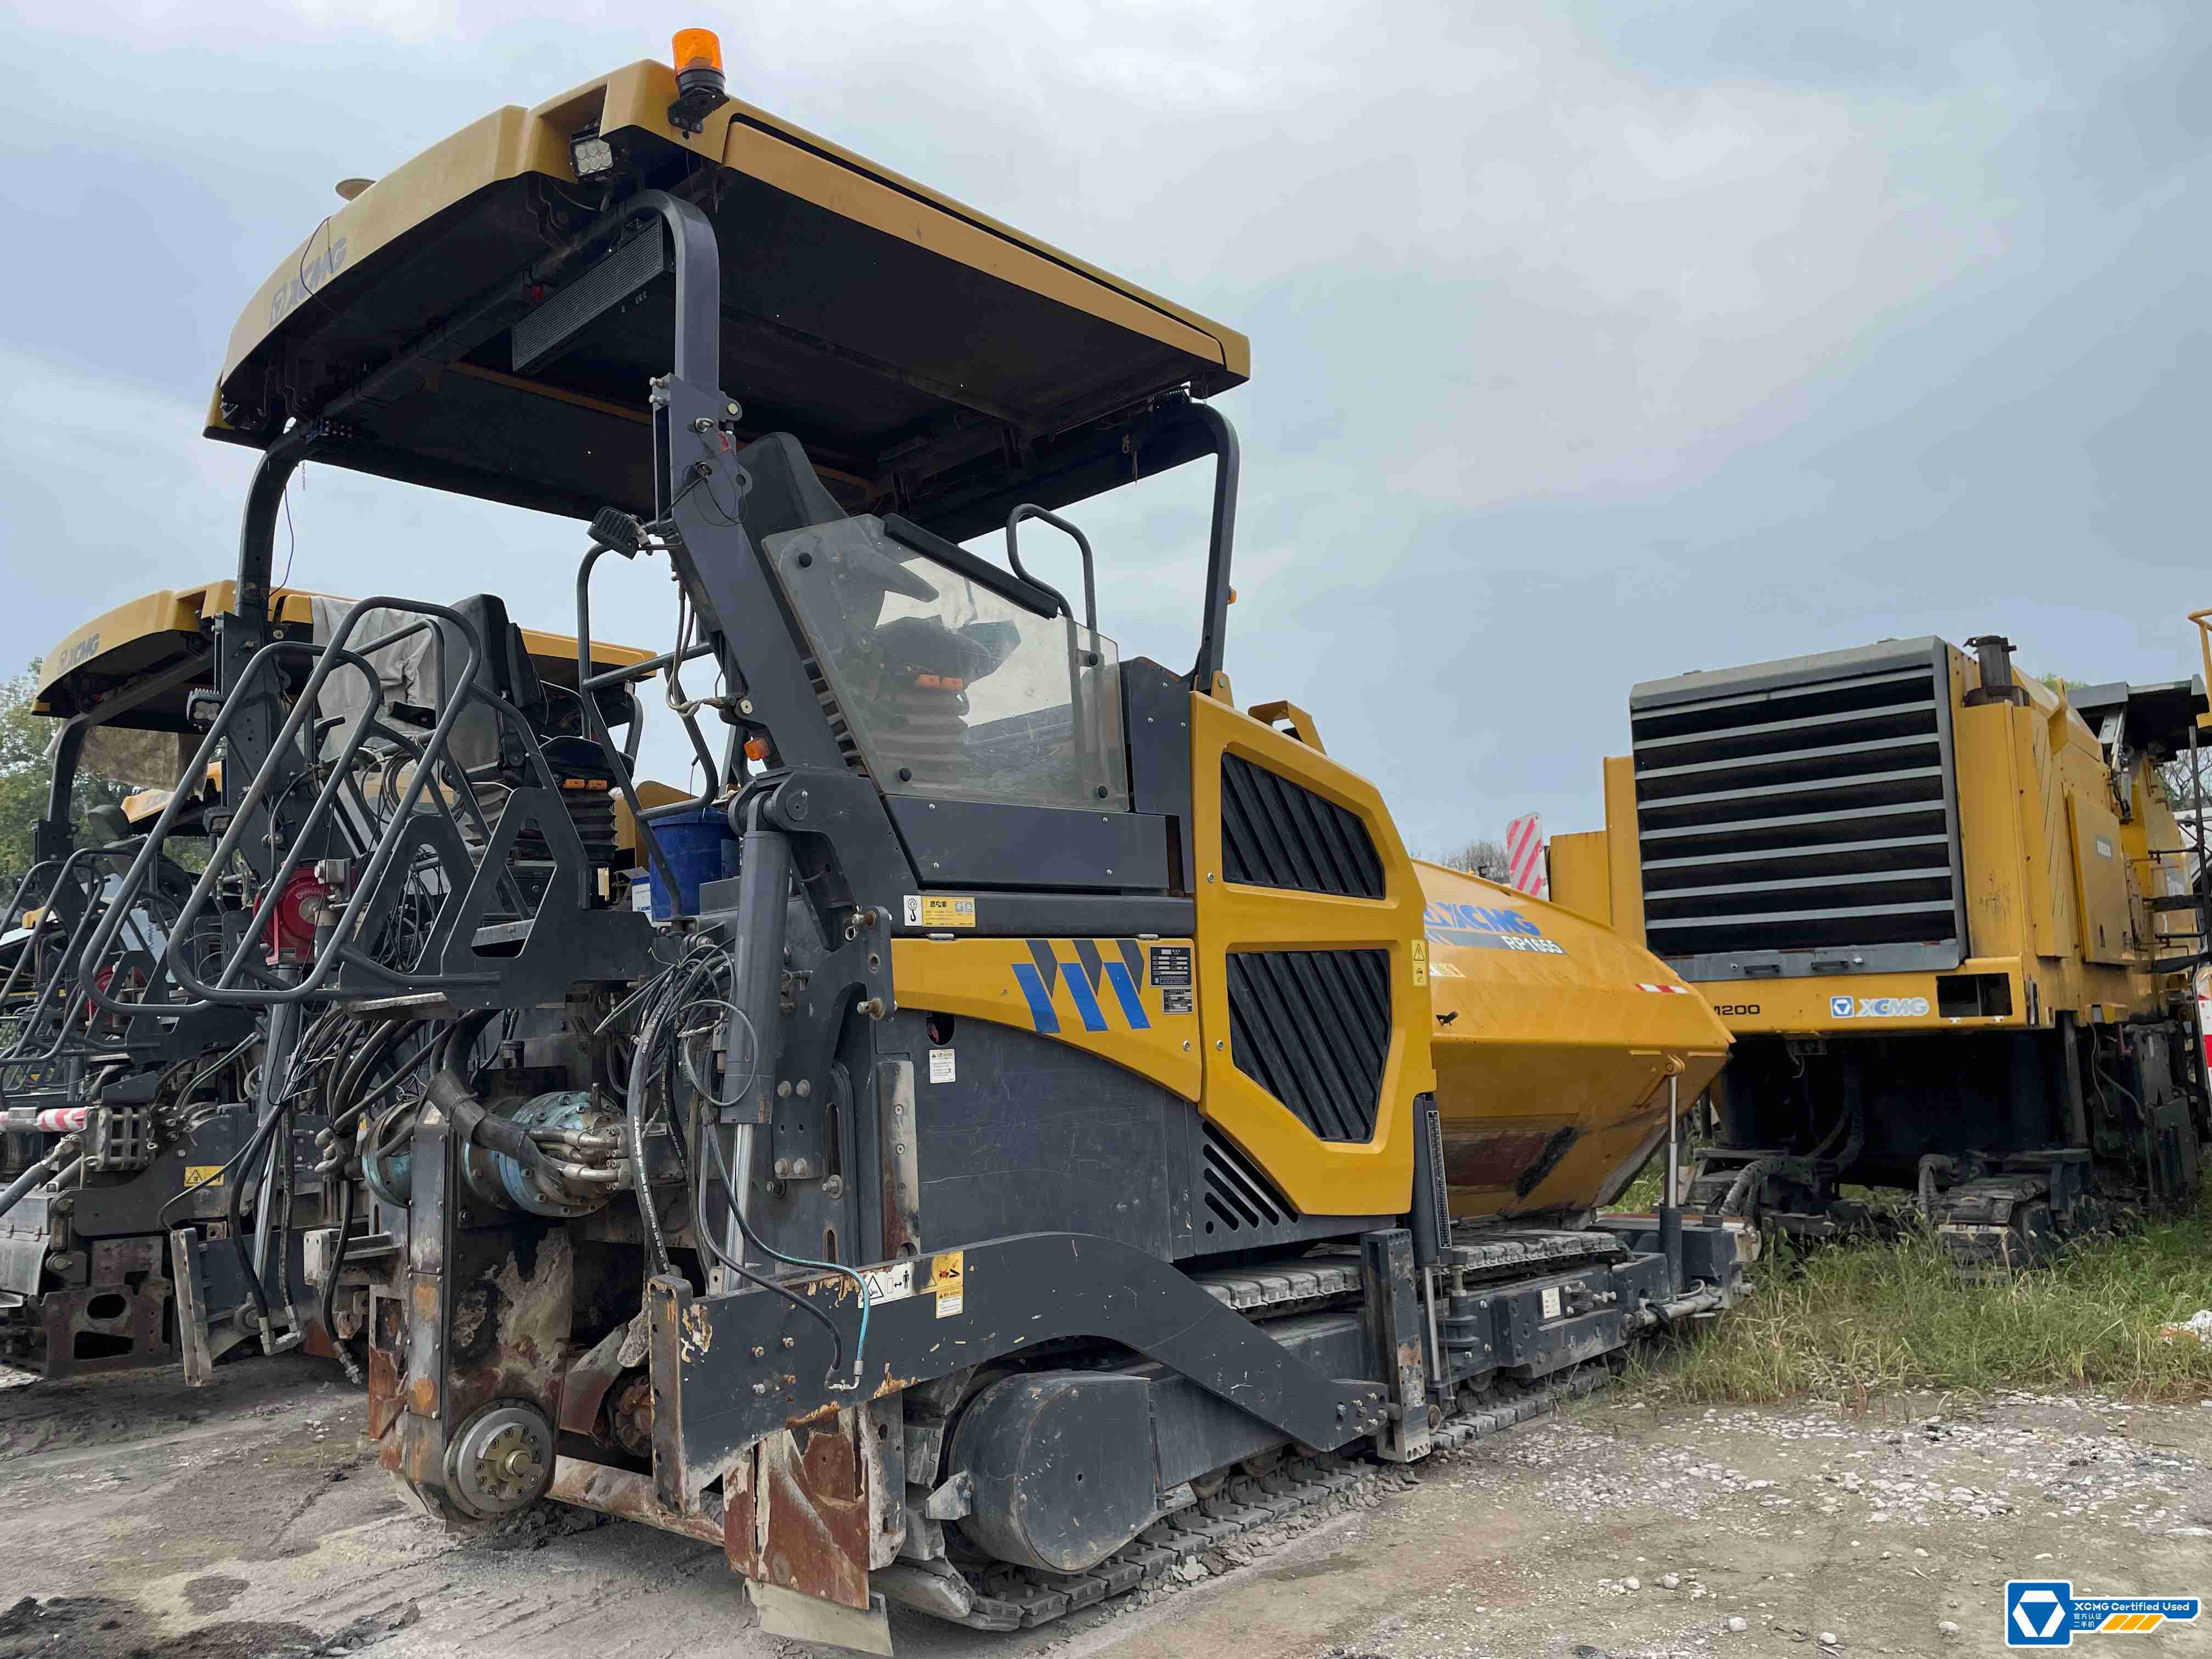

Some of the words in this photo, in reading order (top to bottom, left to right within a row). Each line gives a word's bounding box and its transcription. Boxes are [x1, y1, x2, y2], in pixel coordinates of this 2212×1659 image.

[1449, 904, 1541, 937] XCMG
[1501, 935, 1564, 955] RP1655
[1856, 997, 1929, 1017] XCMG
